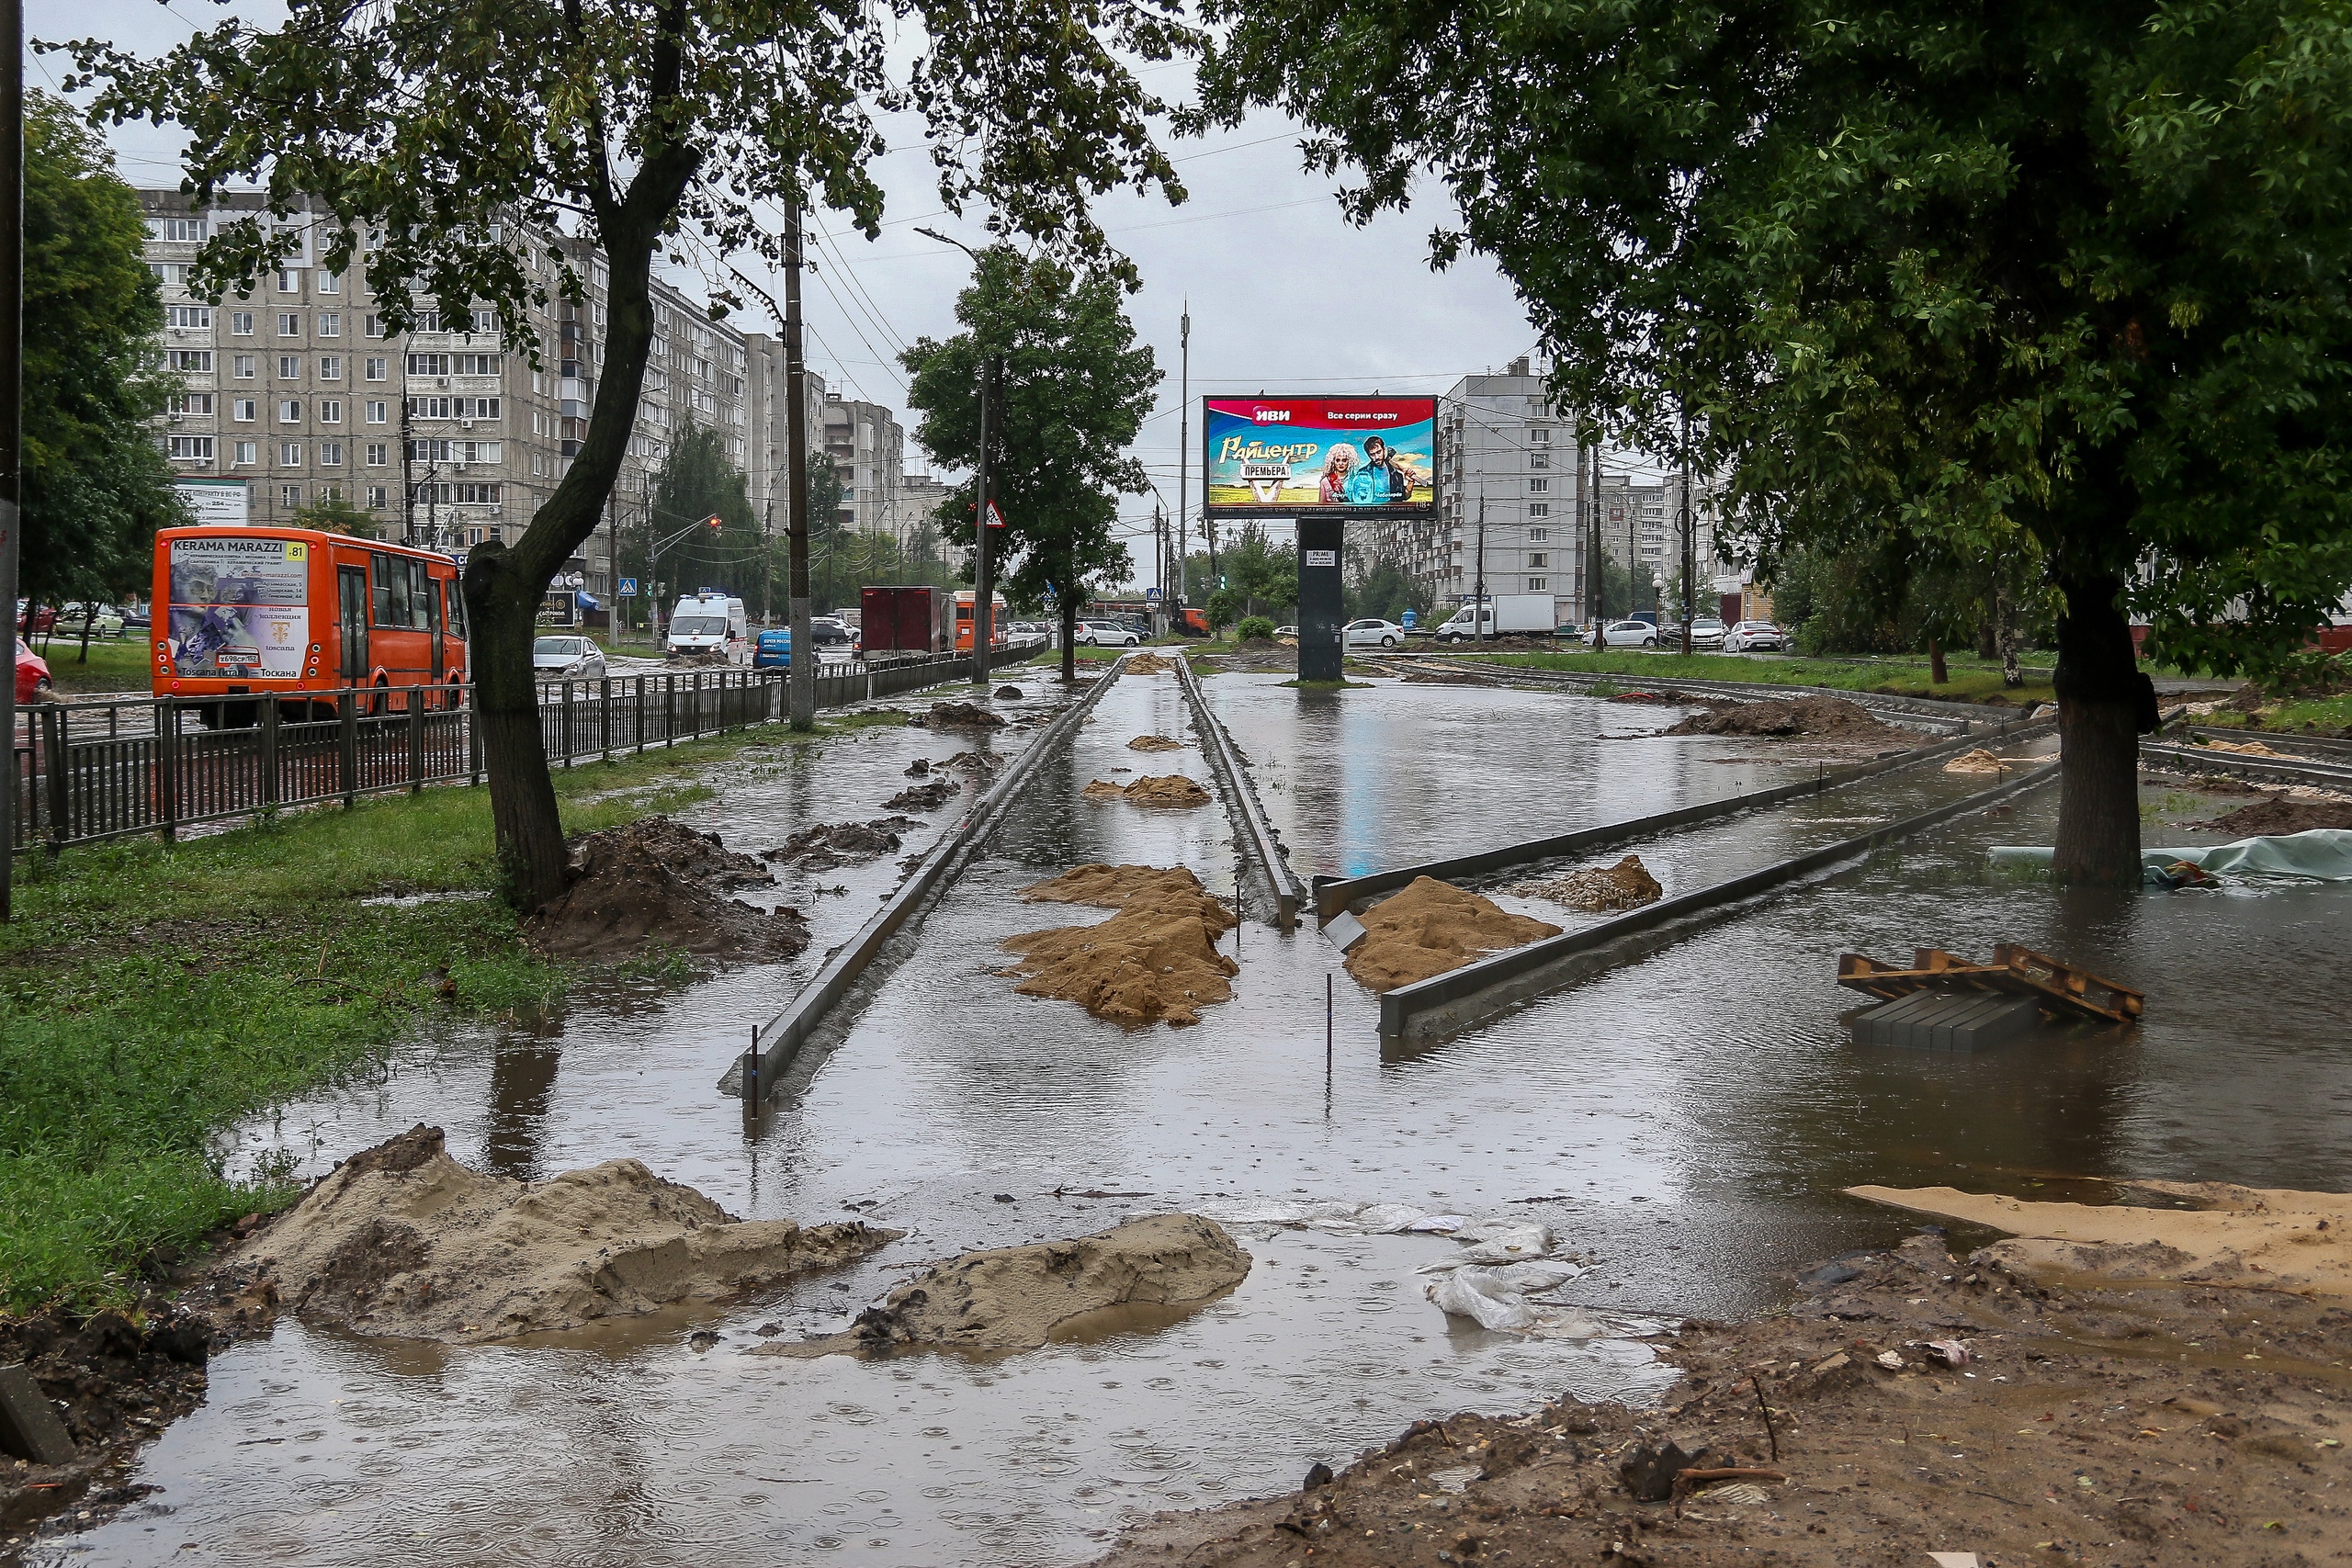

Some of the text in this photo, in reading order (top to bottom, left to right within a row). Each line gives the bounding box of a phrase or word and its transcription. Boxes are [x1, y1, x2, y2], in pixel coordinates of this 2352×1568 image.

[1344, 412, 1372, 421] серии
[1373, 412, 1397, 421] сразу
[1245, 467, 1286, 476] ПРЕМЬЕРА
[175, 541, 282, 552] KERAMA MARAZZI
[292, 547, 302, 557] 81
[182, 668, 216, 677] Toscana
[261, 669, 297, 677] Тоскана
